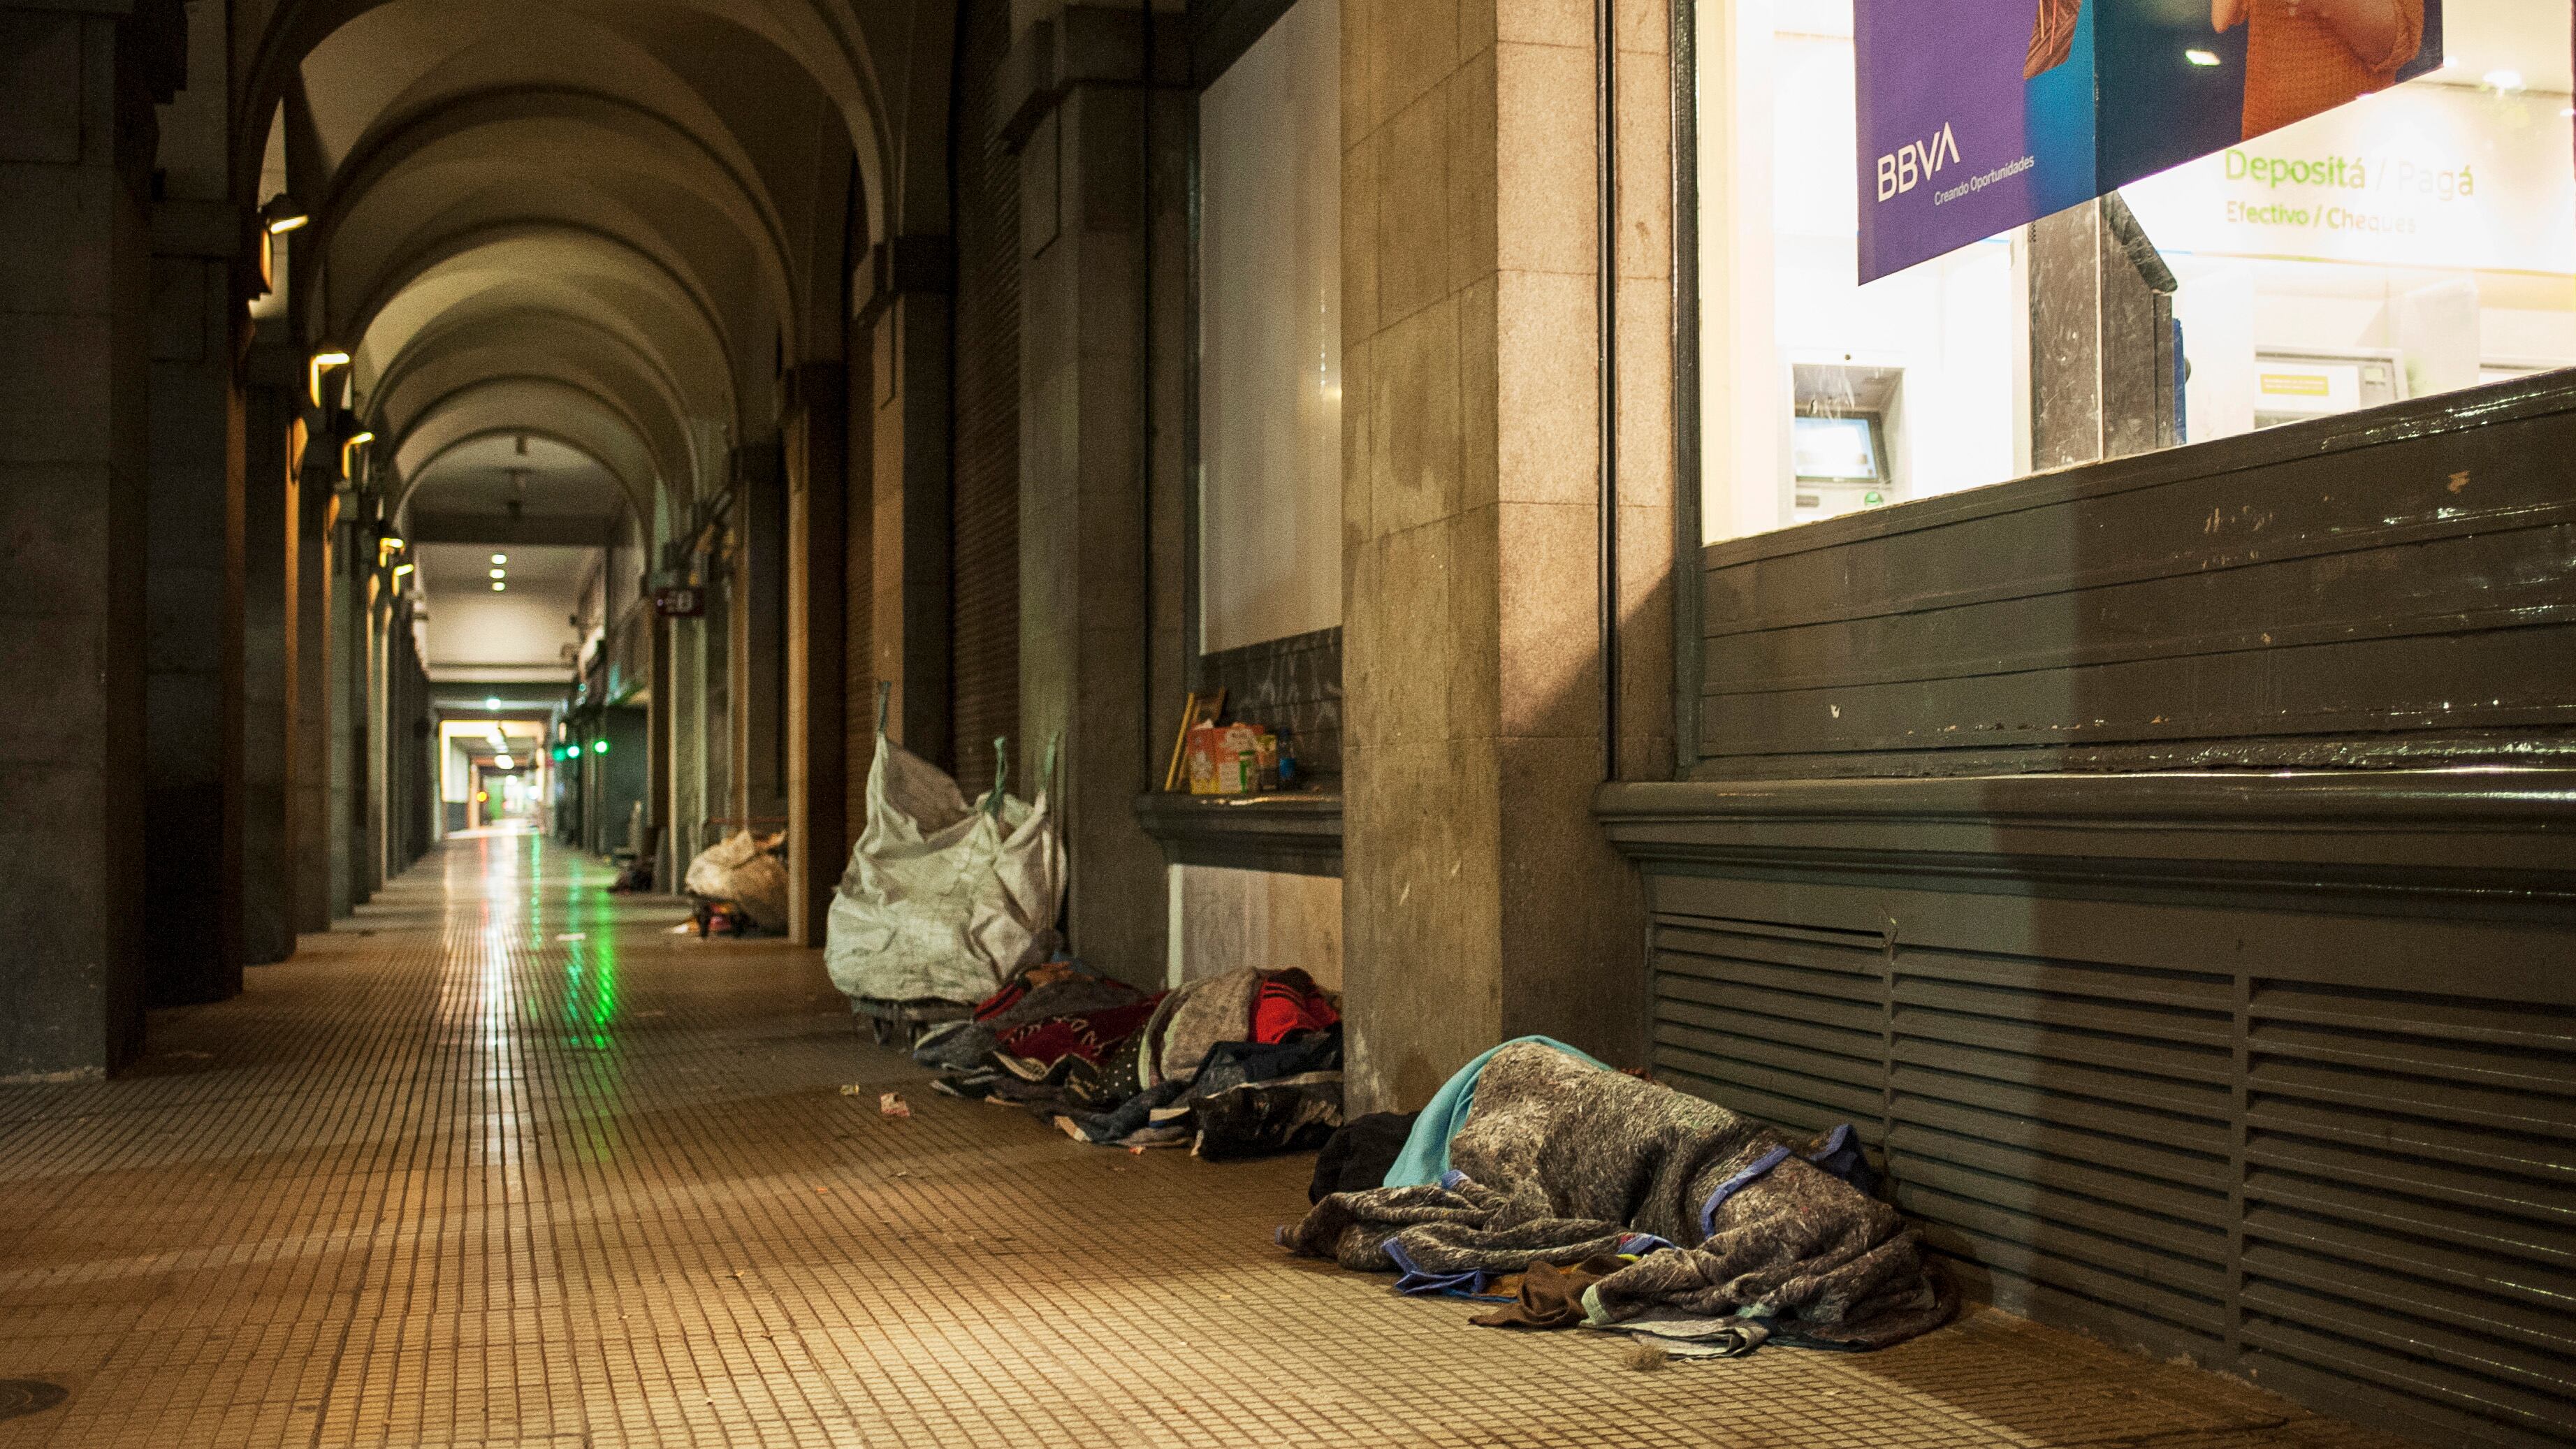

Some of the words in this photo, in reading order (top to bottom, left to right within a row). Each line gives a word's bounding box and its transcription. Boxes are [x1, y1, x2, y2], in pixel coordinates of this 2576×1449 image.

[1877, 122, 1960, 203] BBVA
[1934, 182, 1969, 205] Creando
[1970, 155, 2035, 193] Oportunidades
[2225, 149, 2366, 189] Depositá
[2398, 160, 2474, 201] Pagá
[2227, 201, 2309, 226] Efectivo
[2326, 207, 2417, 234] Cheques
